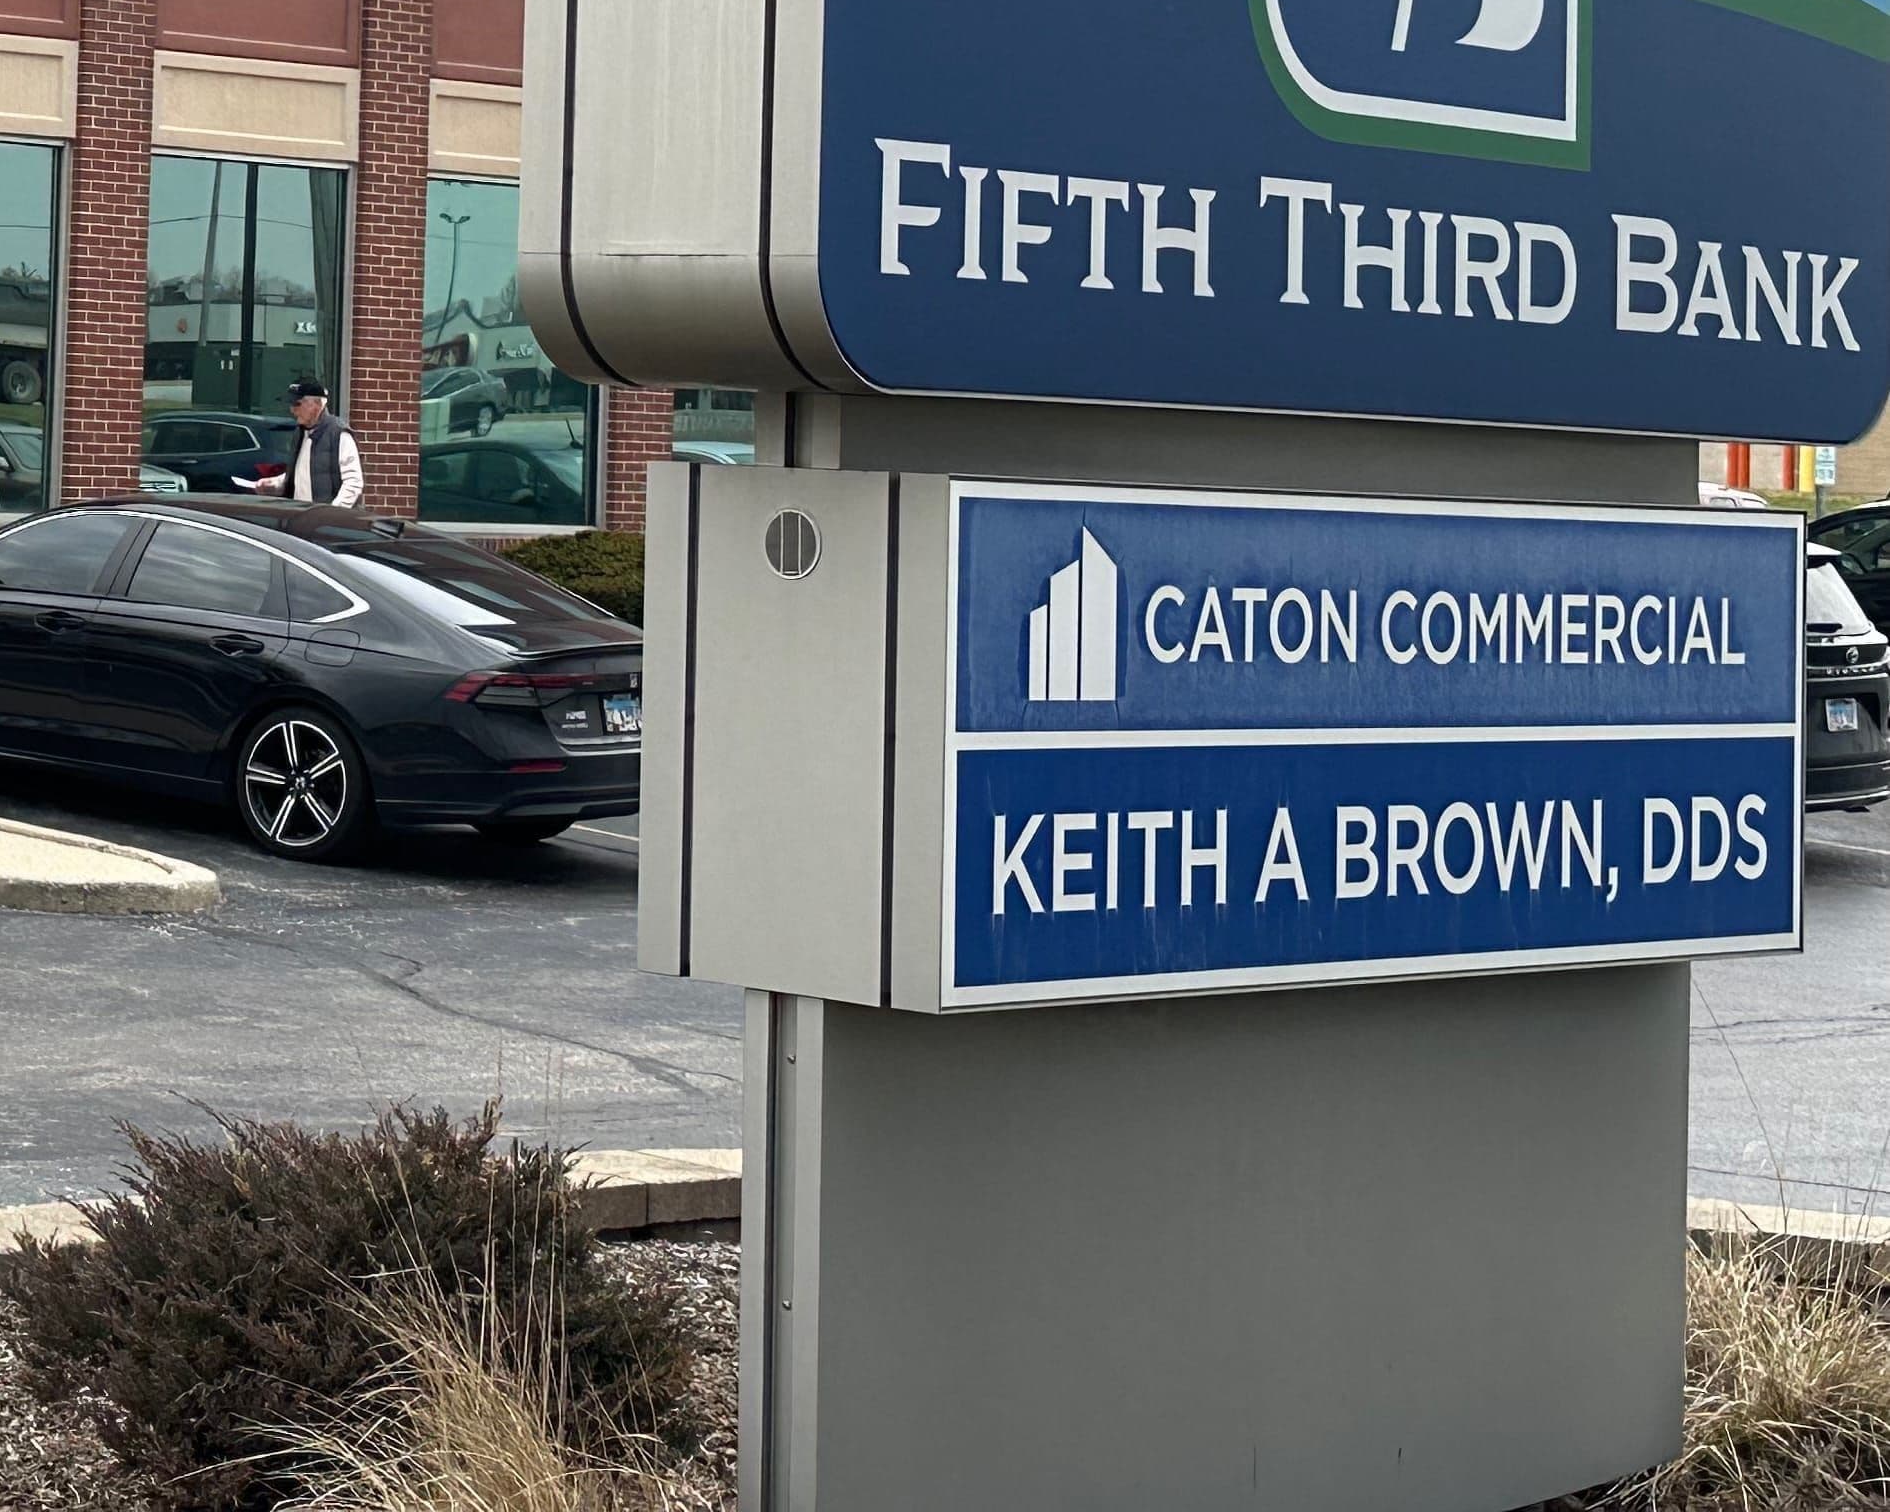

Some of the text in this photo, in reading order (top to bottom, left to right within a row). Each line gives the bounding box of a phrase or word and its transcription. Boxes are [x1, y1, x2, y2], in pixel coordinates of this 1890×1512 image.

[875, 138, 1860, 351] FIFTH THIRD BANK
[1146, 585, 1745, 665] CATON COMMERCIAL
[993, 794, 1767, 914] KEITH A BROWN, DDS
